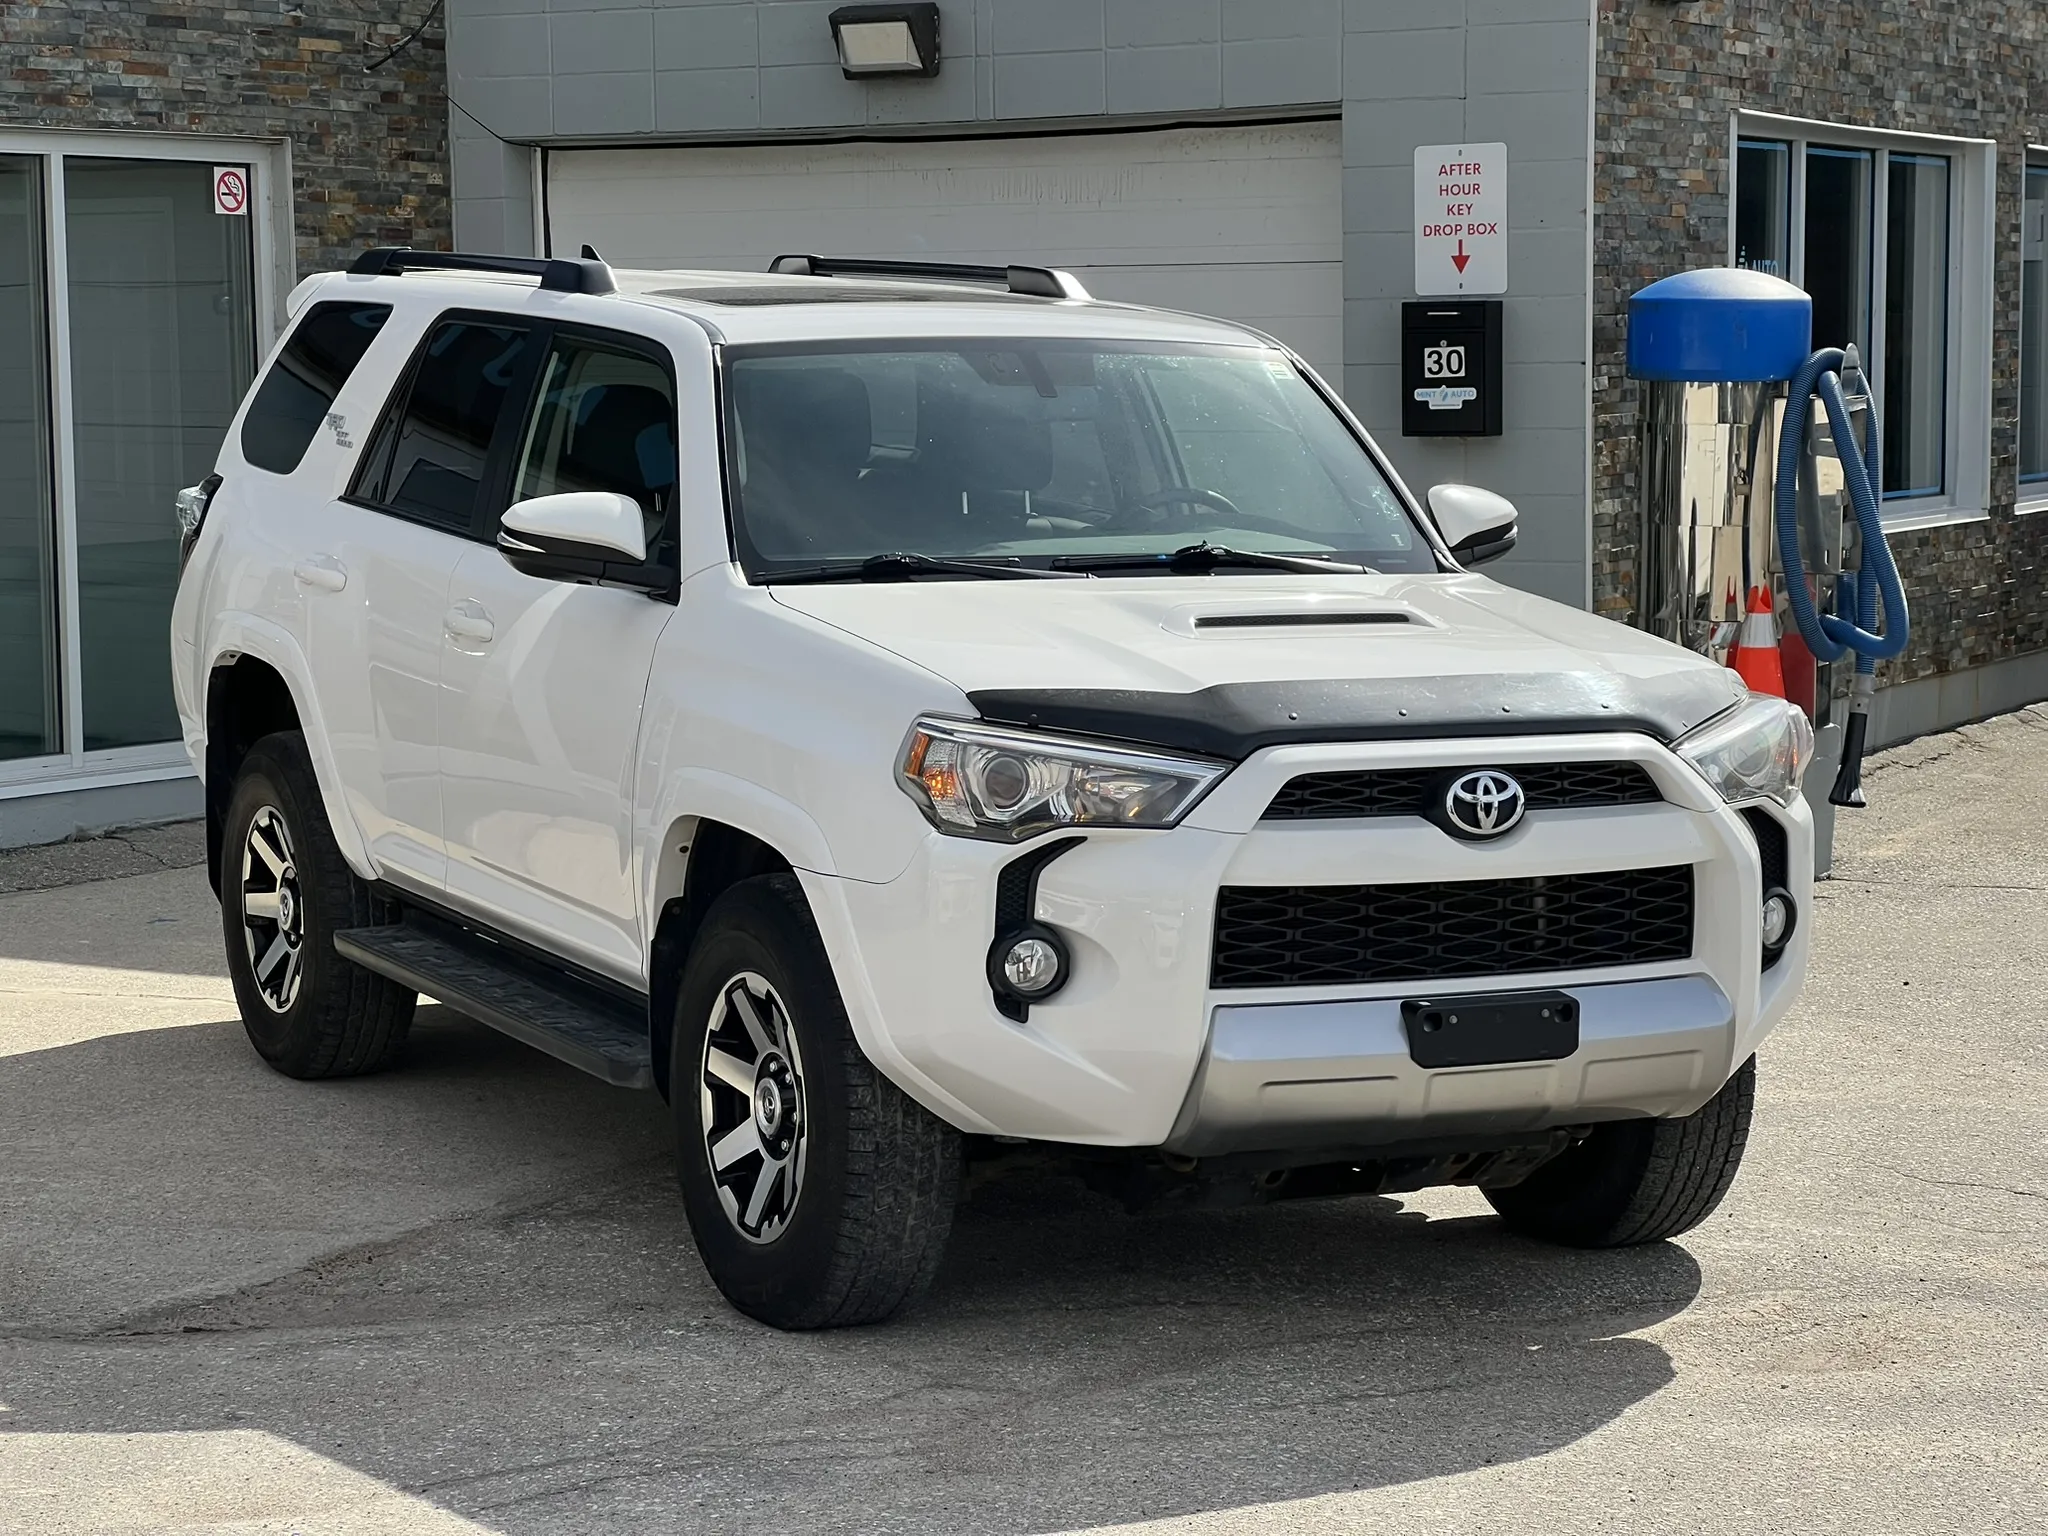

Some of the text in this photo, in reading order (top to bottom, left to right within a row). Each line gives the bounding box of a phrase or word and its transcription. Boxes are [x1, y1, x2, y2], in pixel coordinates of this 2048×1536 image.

[1438, 162, 1482, 177] AFTER
[1439, 183, 1481, 196] HOUR
[1446, 203, 1474, 216] KEY
[1423, 222, 1498, 237] DROP BOX
[1426, 349, 1464, 376] 30
[1416, 389, 1475, 399] MINT AUTO
